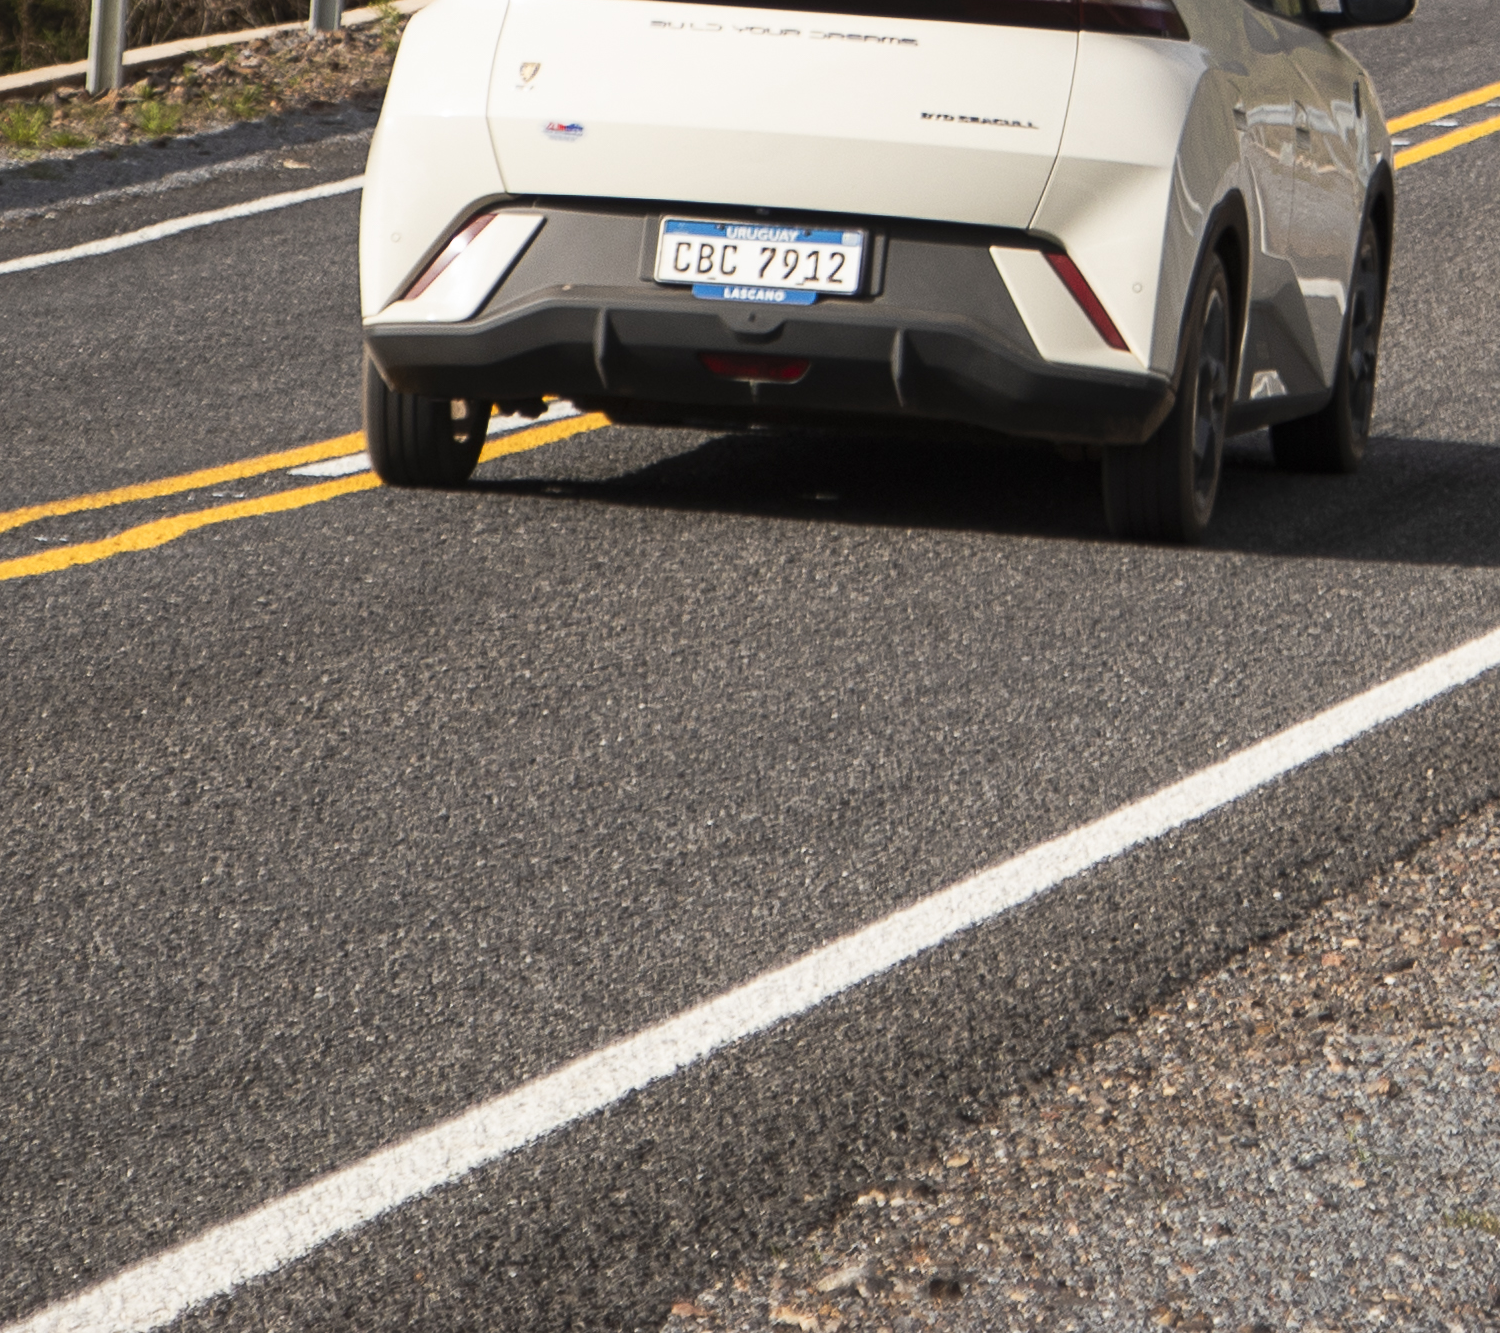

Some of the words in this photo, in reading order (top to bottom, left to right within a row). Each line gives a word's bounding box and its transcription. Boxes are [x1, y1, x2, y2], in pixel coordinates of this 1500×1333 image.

[650, 20, 723, 32] BULD
[809, 30, 919, 47] DREAMS
[725, 226, 800, 242] URUGUAY
[674, 242, 738, 276] CBC
[758, 246, 846, 284] 7912
[723, 286, 787, 302] LASCANO
